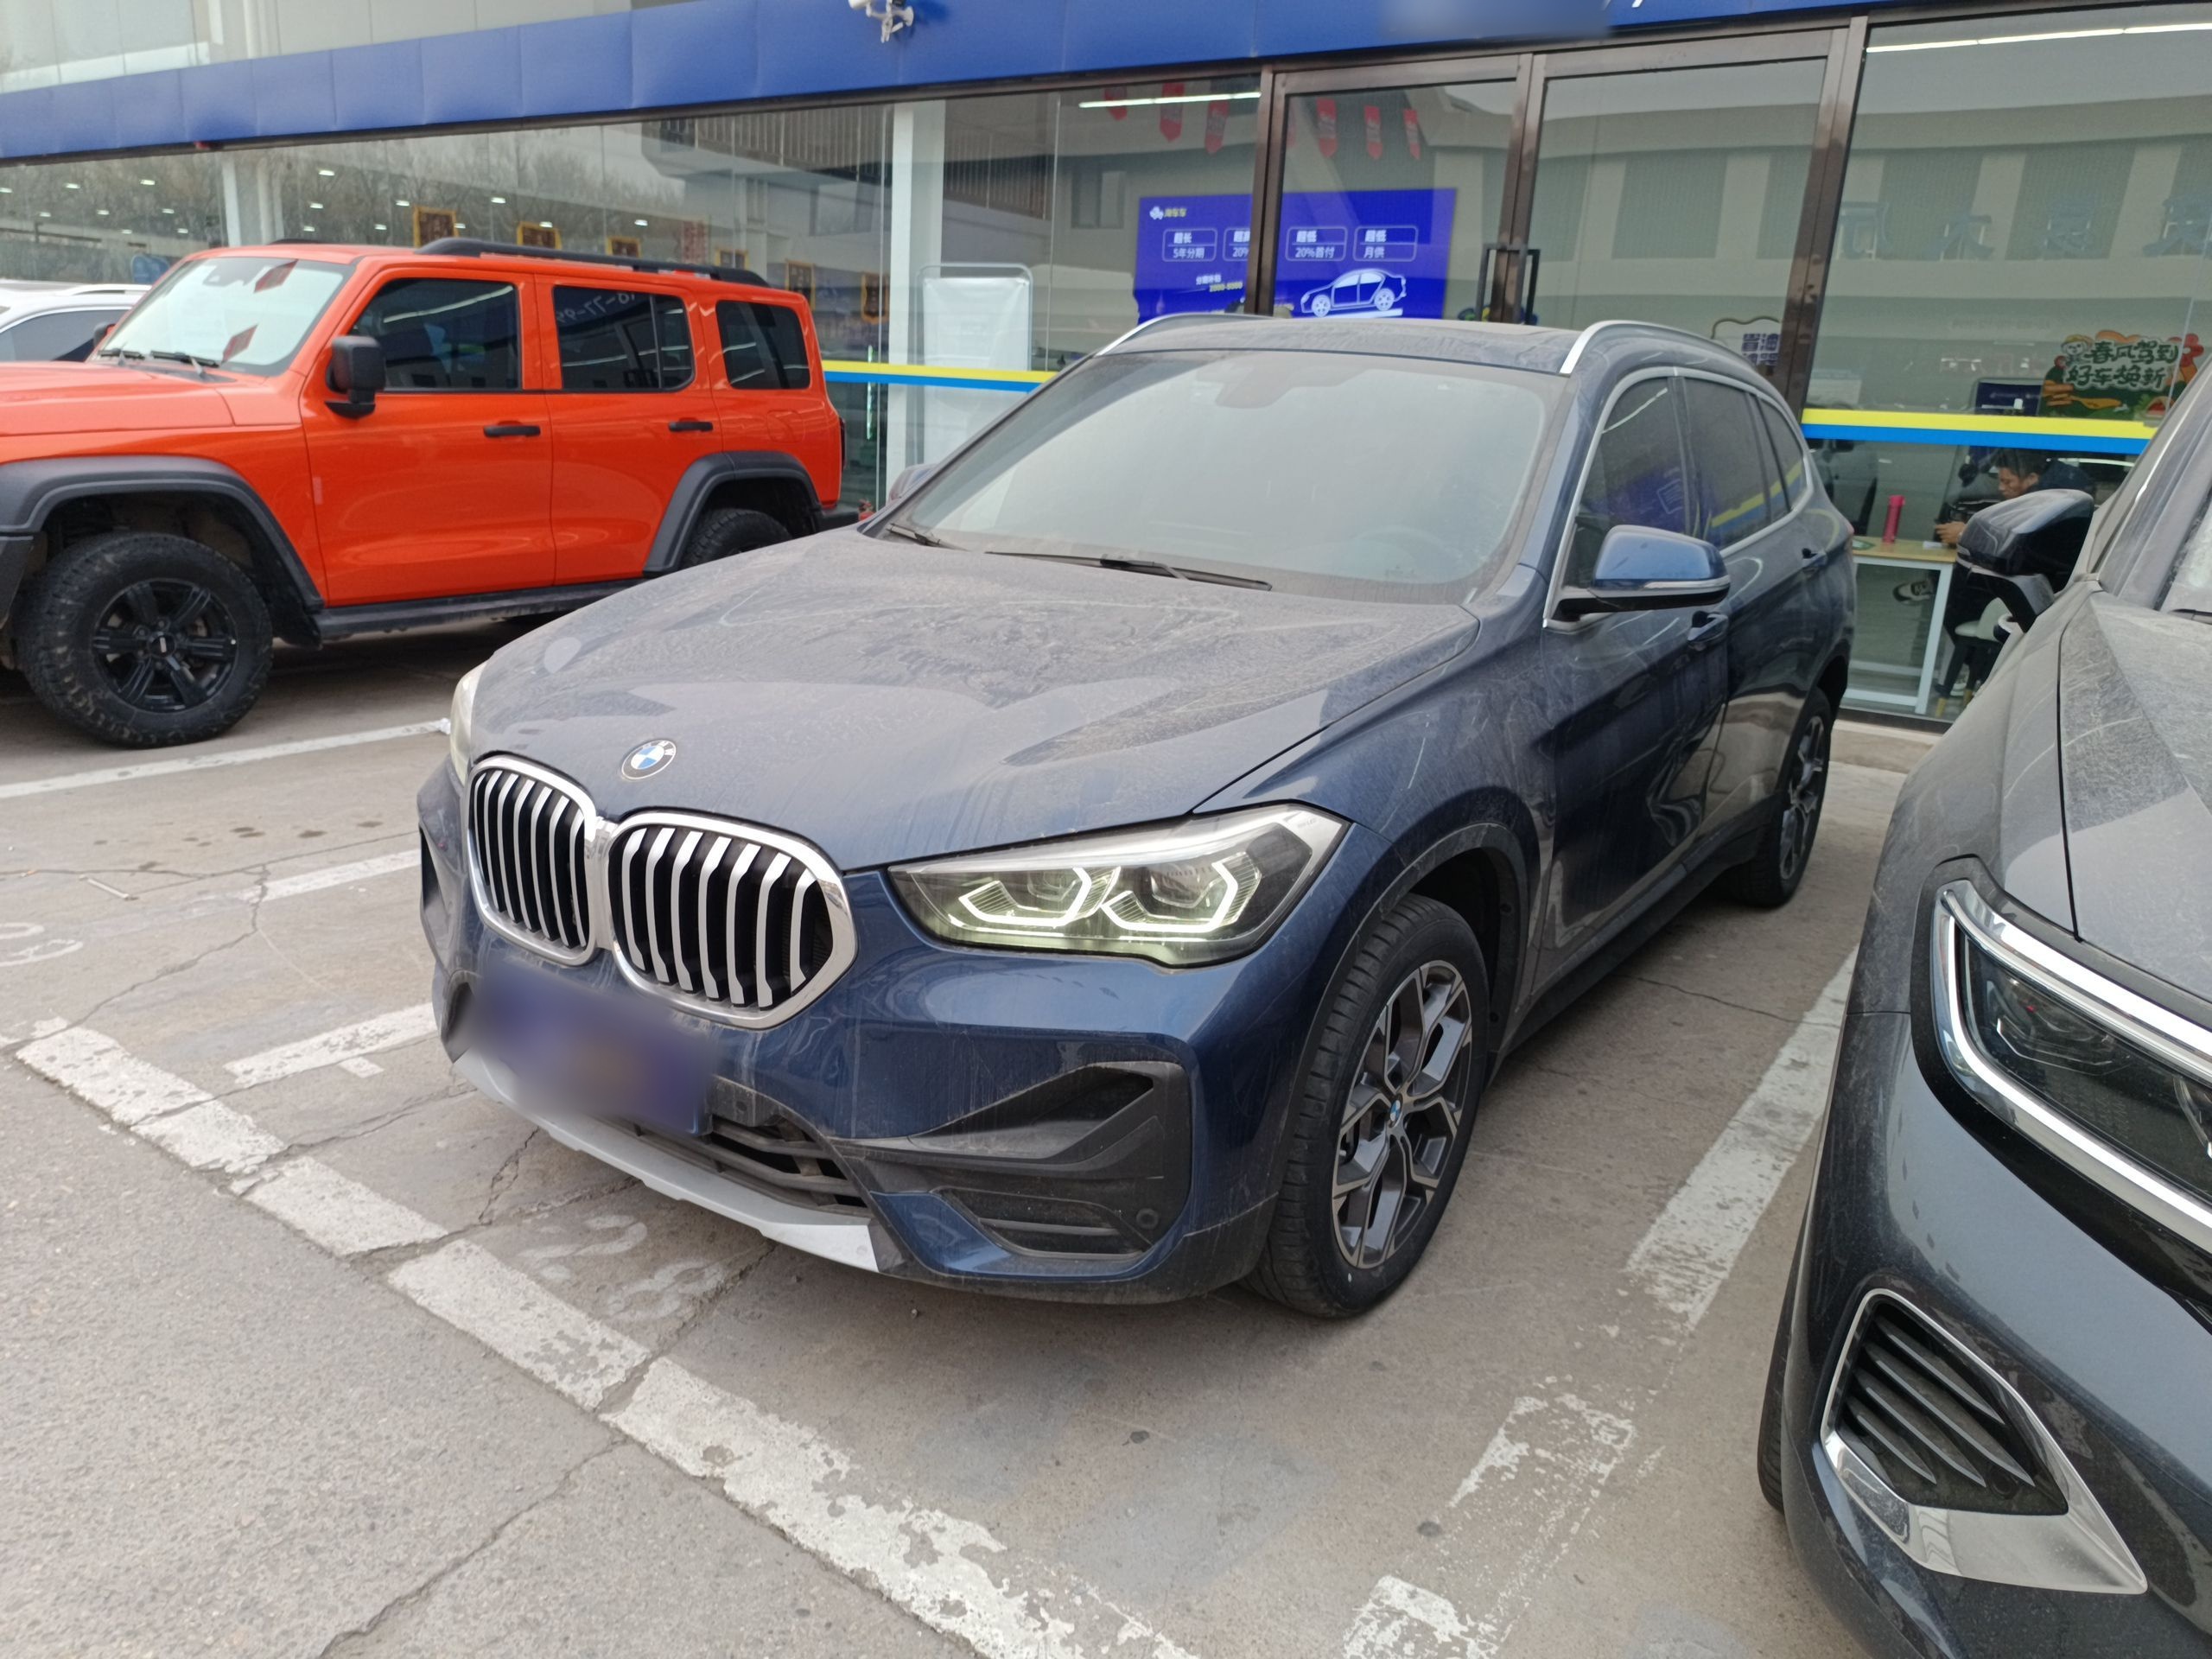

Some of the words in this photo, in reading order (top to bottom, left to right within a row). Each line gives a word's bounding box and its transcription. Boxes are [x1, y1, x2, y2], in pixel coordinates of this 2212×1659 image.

[2084, 339, 2179, 365] 春风驾到
[2066, 363, 2166, 389] 好车换新
